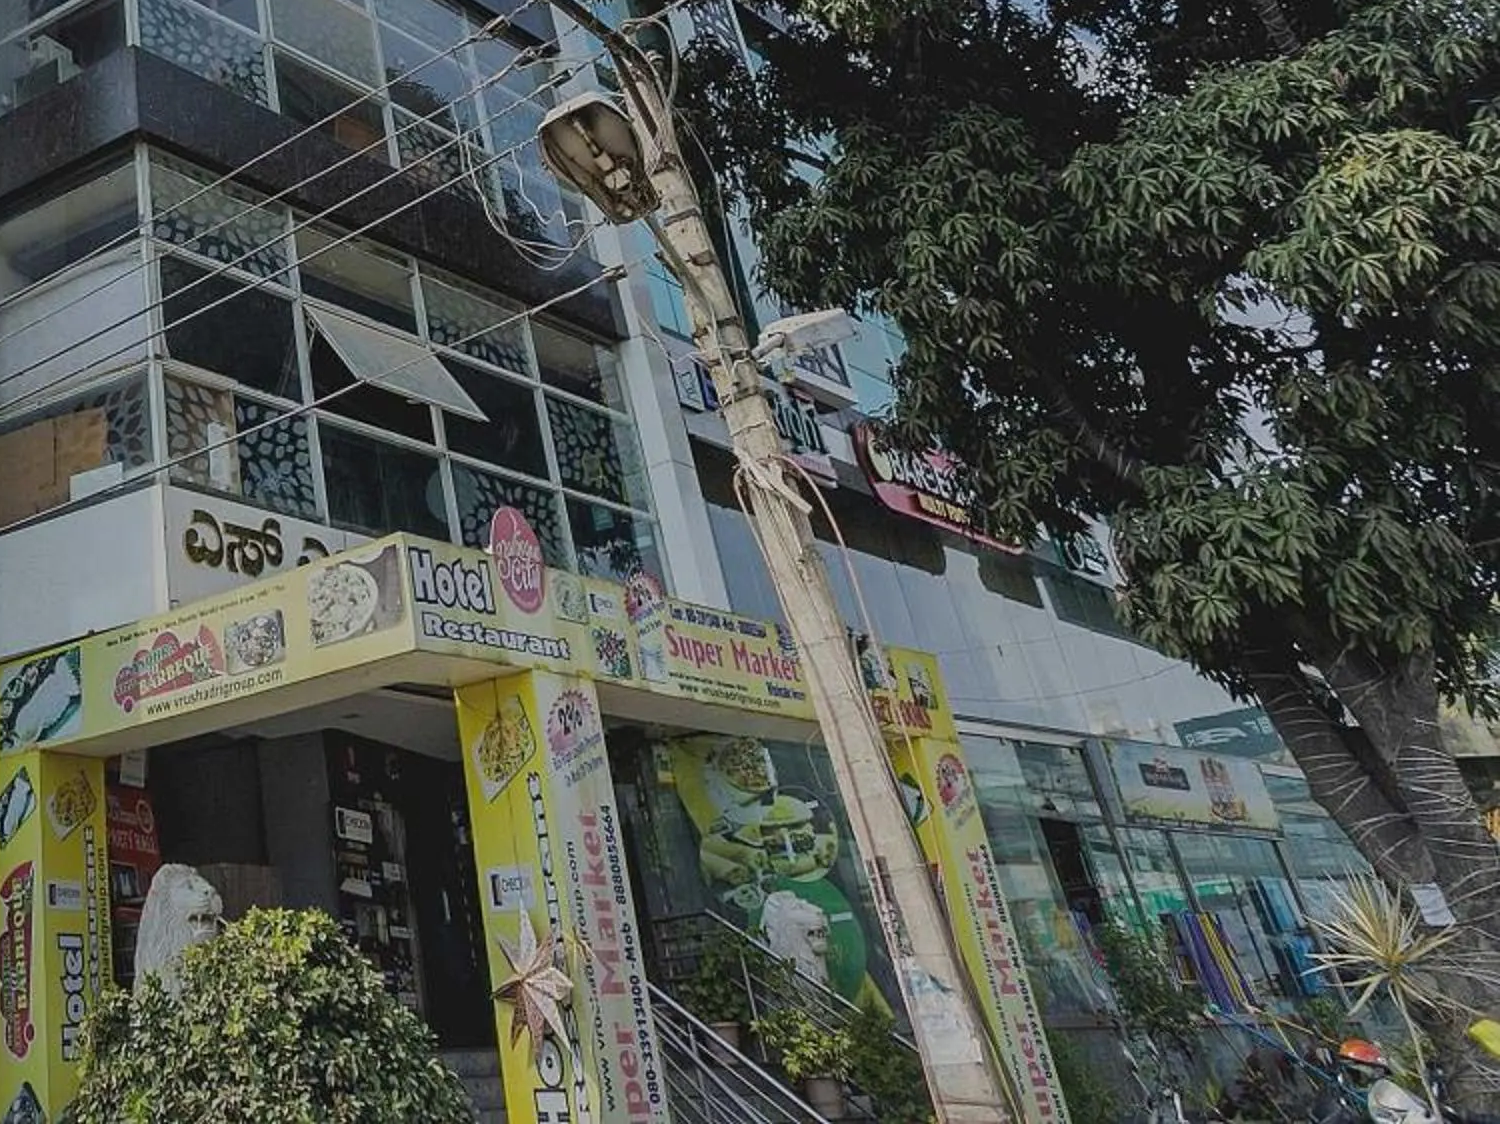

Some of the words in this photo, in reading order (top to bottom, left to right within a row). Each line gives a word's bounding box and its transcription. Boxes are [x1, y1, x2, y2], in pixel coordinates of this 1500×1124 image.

[408, 547, 497, 615] Hotel
[421, 610, 571, 661] Restaurant
[664, 624, 724, 670] Super
[729, 637, 802, 683] Market
[580, 809, 628, 995] Market
[600, 804, 627, 905] 8880855664
[11, 875, 29, 1010] BARBEQUE
[966, 845, 1019, 996] Market
[57, 932, 86, 1062] Hotel
[1015, 1016, 1053, 1124] uper
